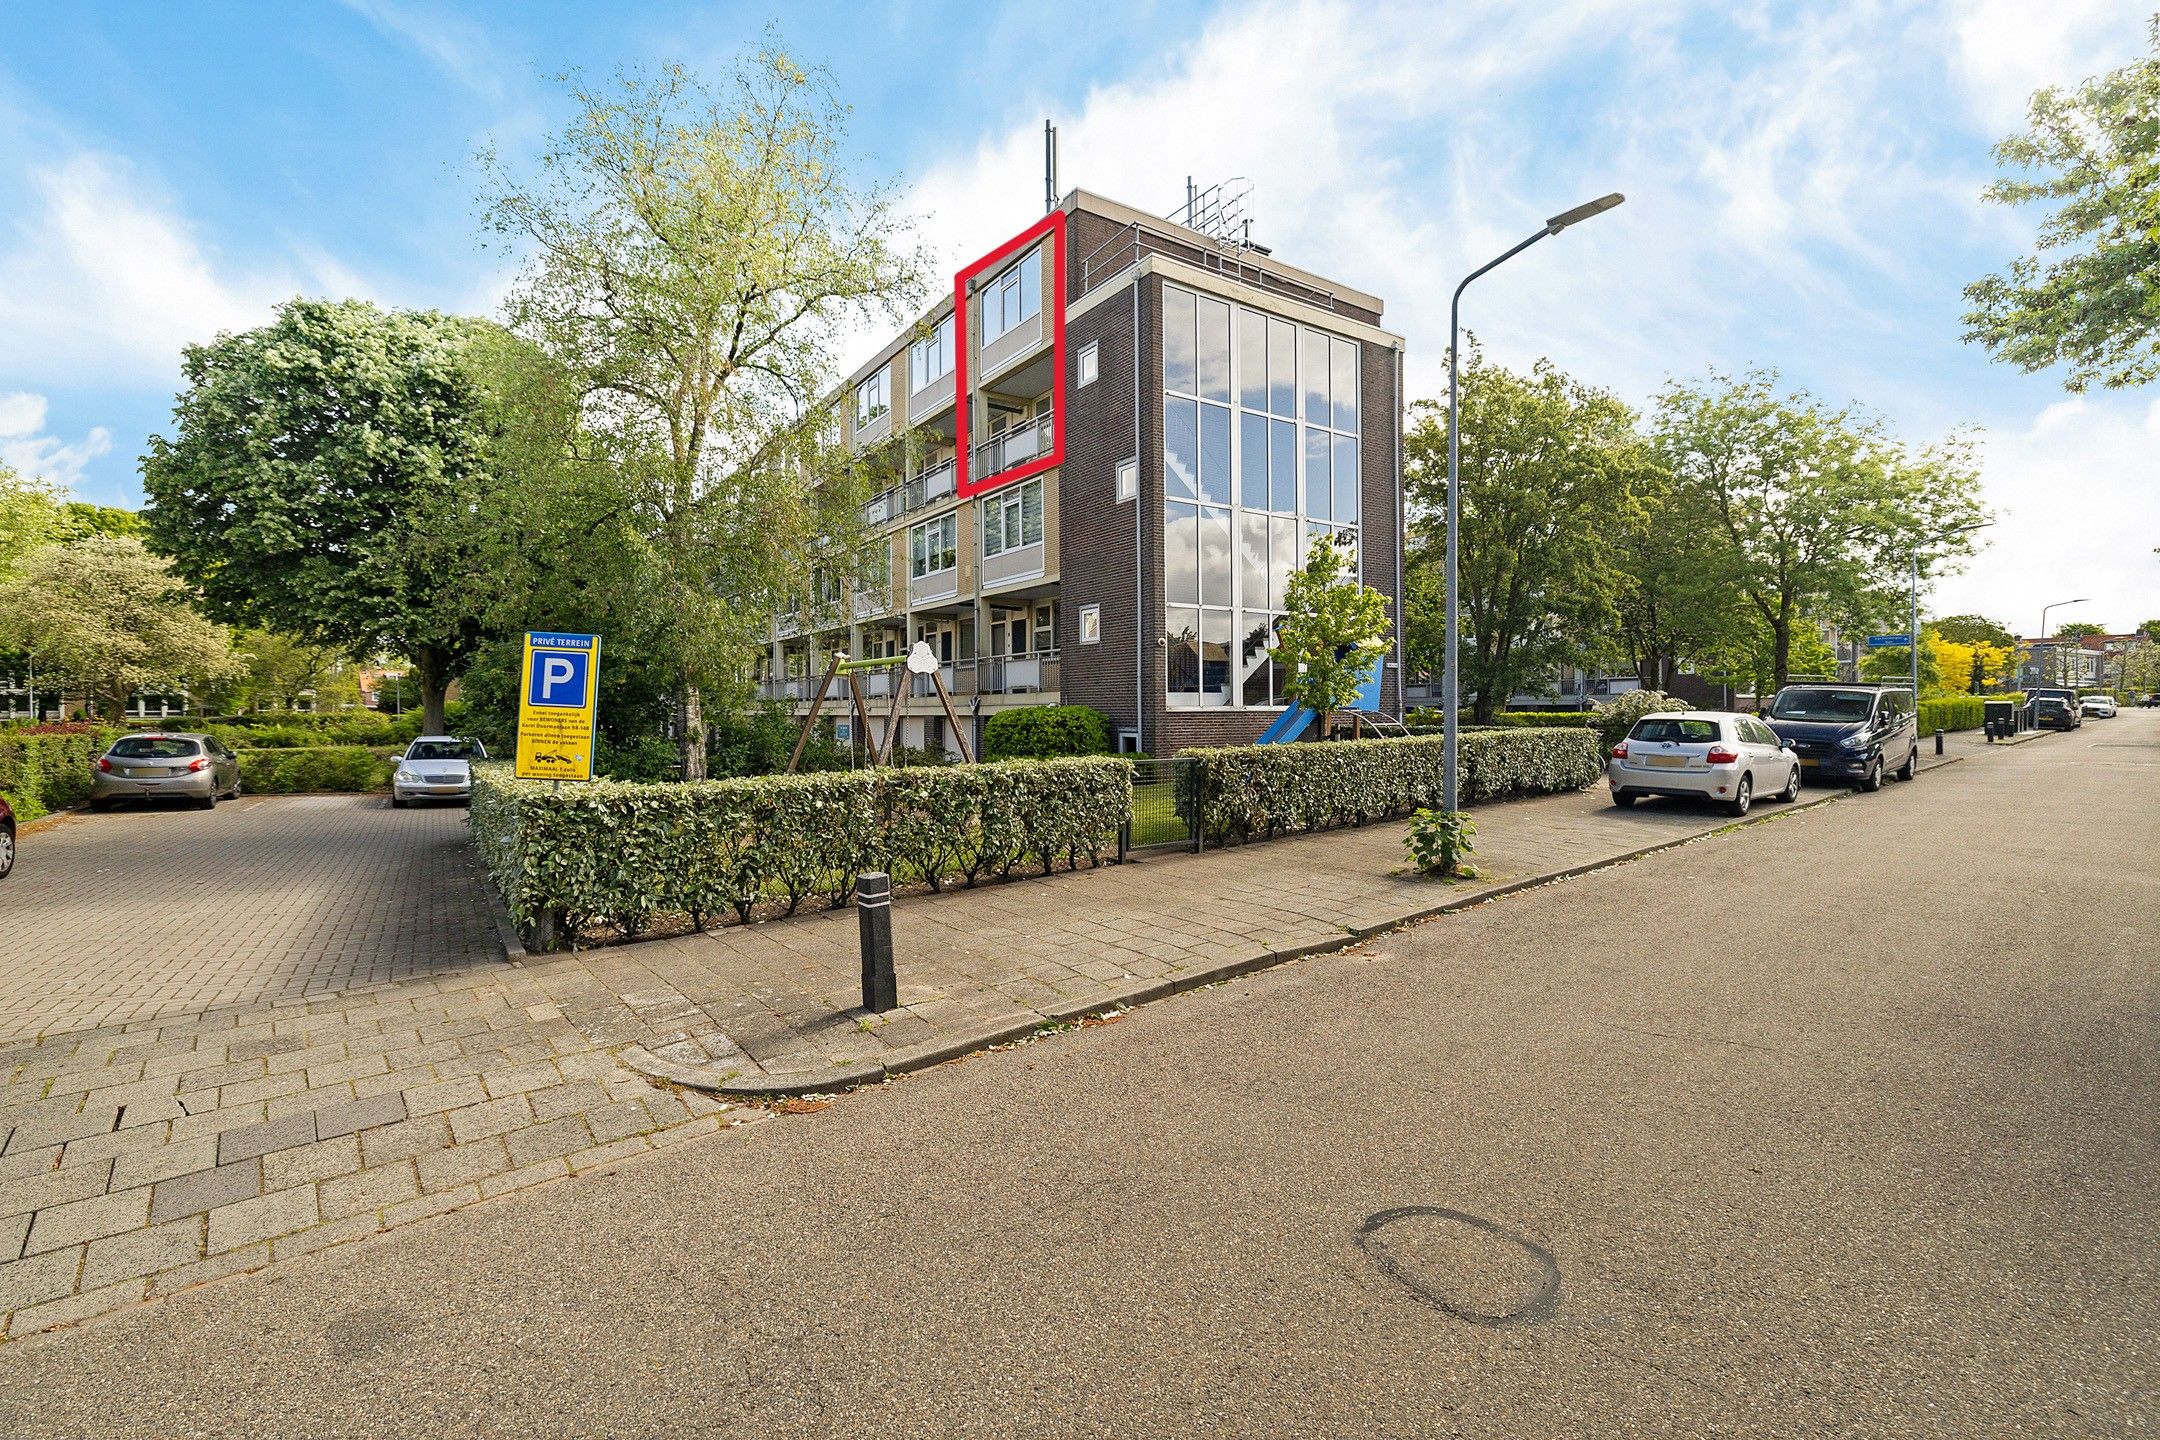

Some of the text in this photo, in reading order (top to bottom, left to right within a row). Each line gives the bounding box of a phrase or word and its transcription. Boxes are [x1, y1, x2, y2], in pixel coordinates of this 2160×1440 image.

[533, 637, 589, 647] PRIVÉ TERREIN
[542, 657, 574, 699] P
